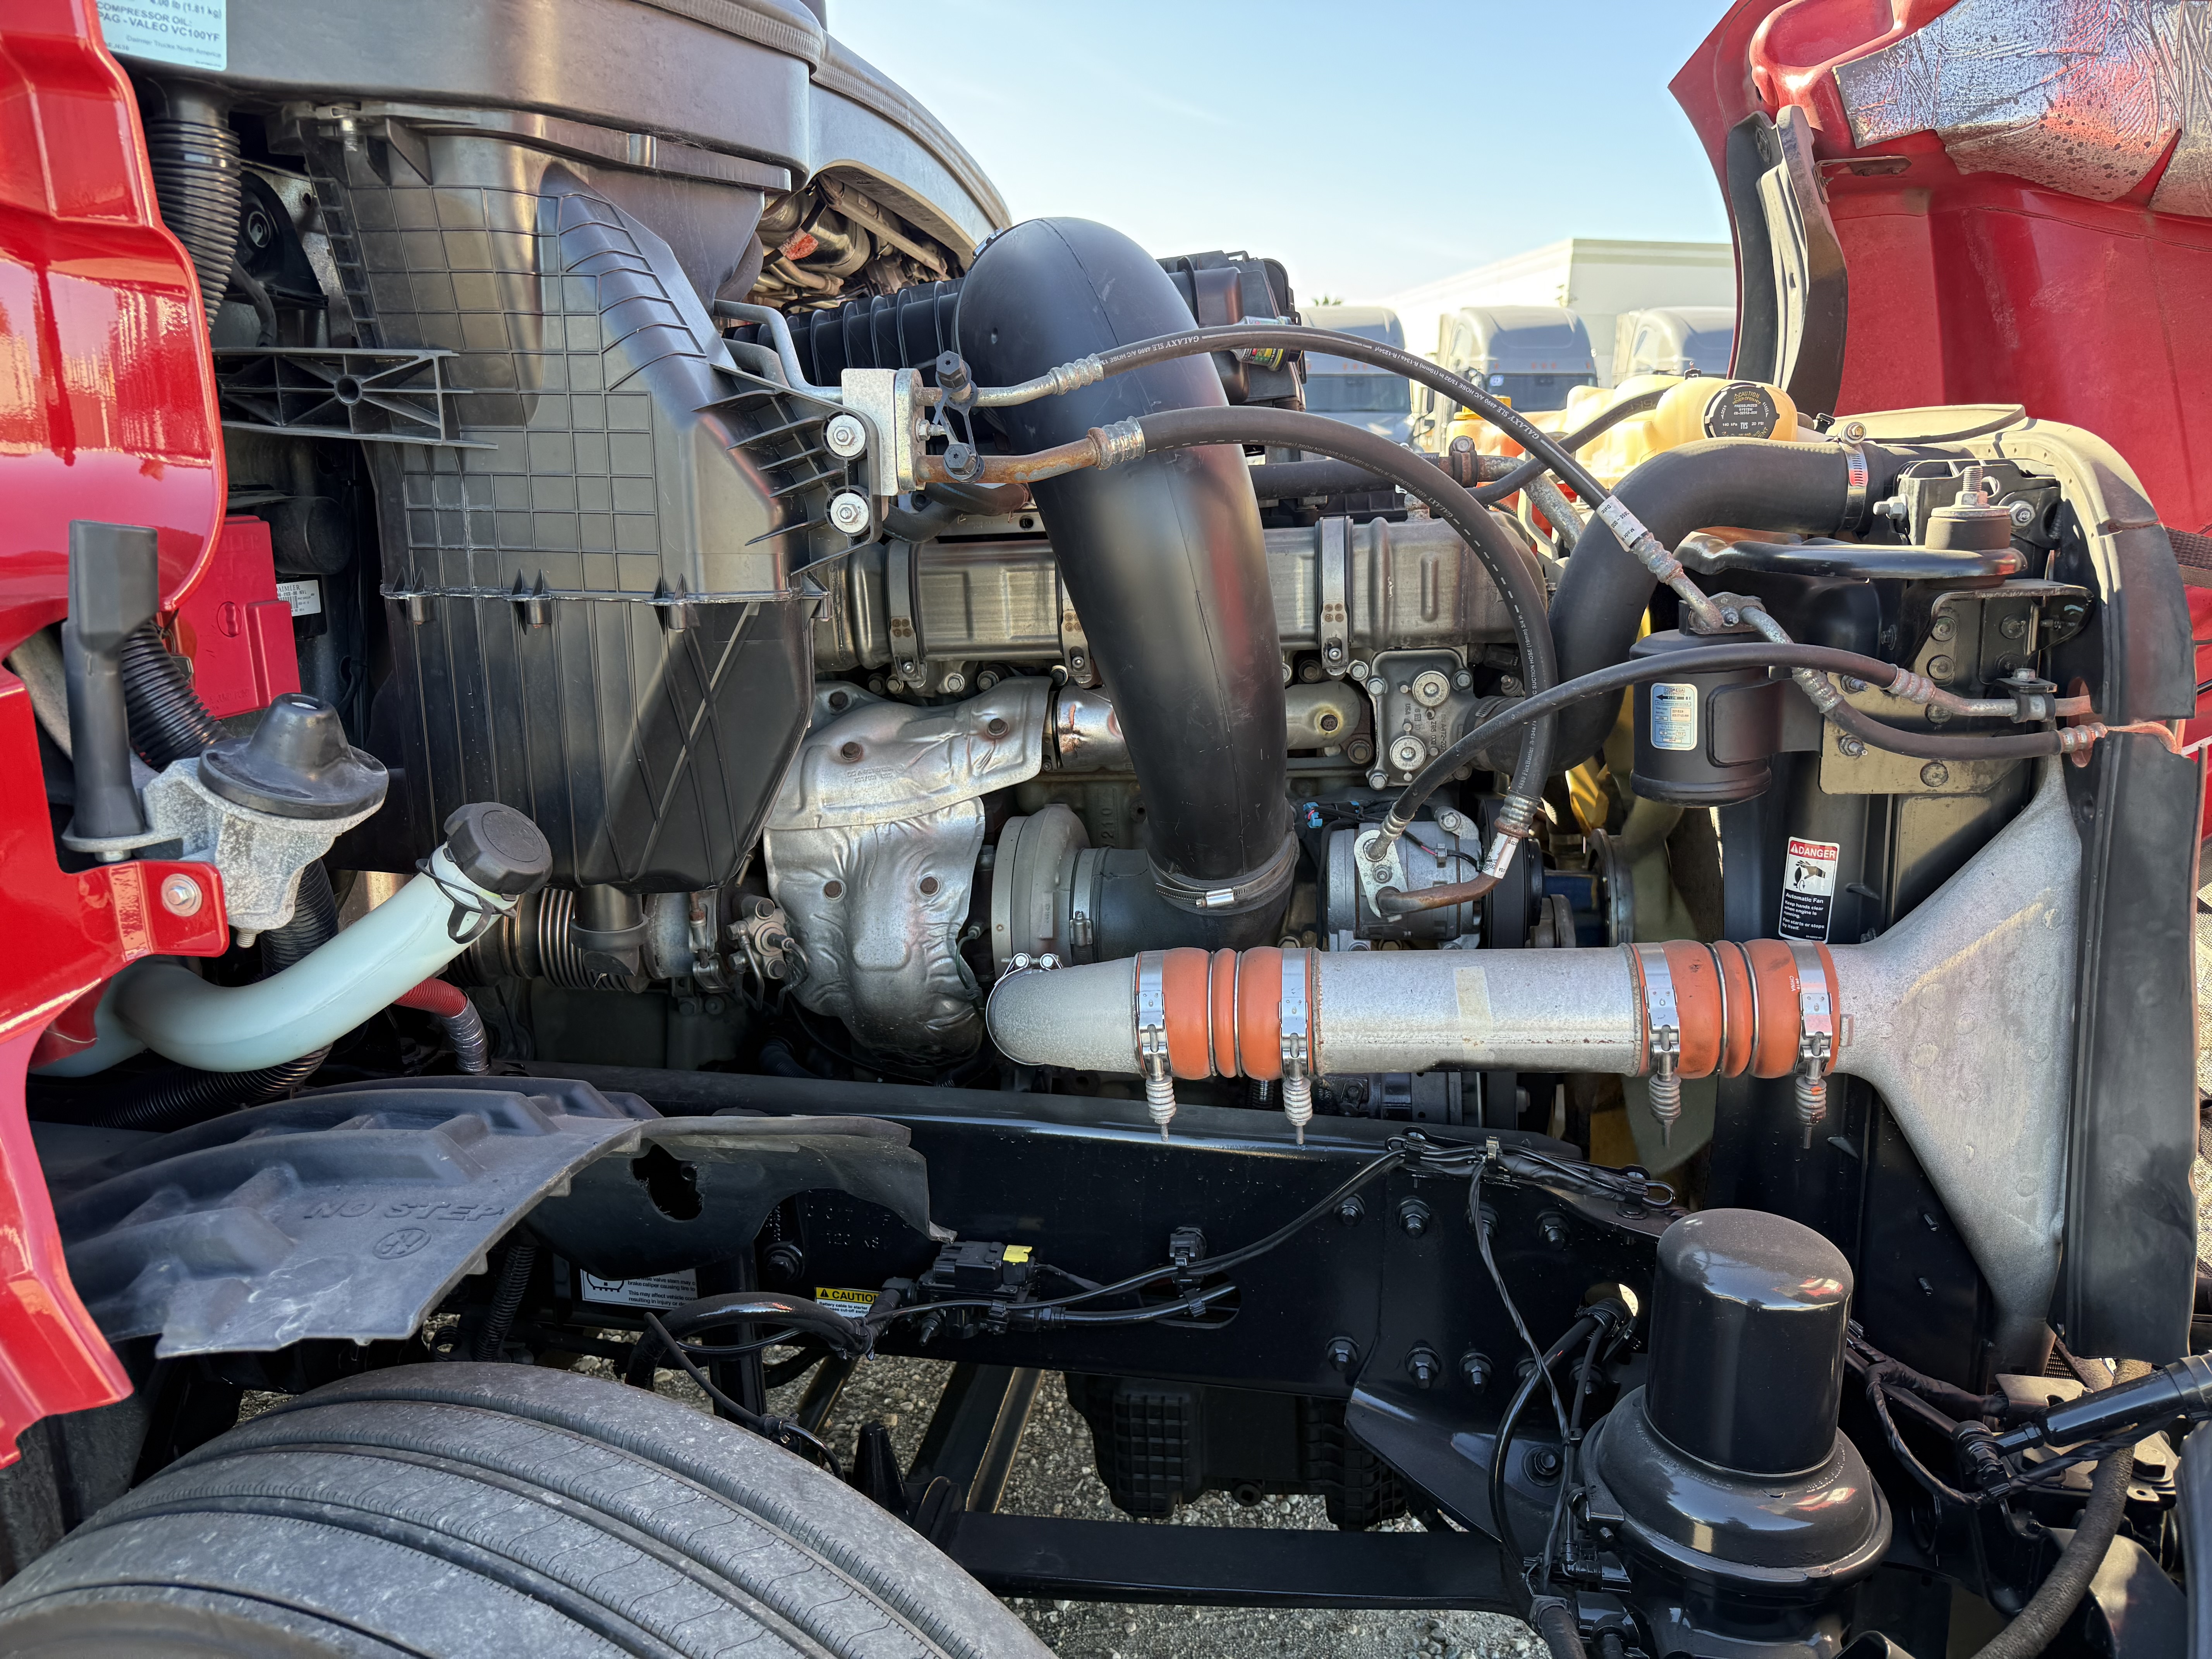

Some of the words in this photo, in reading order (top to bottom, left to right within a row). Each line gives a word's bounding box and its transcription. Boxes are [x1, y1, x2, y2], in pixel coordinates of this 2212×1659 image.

[96, 2, 169, 22] COMPRESSOR
[172, 15, 192, 27] OIL:
[129, 17, 168, 32] VALEO
[171, 27, 220, 42] VC100YF
[1152, 343, 1164, 351] SLE
[1166, 335, 1199, 348] GALAXY
[1109, 354, 1126, 362] HOSE
[1420, 363, 1439, 375] (10mm)
[1444, 375, 1458, 386] 13/32
[1458, 383, 1474, 395] HOSE
[1474, 392, 1485, 401] A/C
[1497, 407, 1509, 417] SLE
[1508, 415, 1540, 440] GALAXY
[1314, 447, 1338, 456] SUCTION
[1390, 474, 1416, 491] FlexBarrier
[1425, 497, 1453, 518] GALAXY
[1623, 527, 1635, 538] Made
[1522, 629, 1532, 647] (19mm)
[1522, 747, 1534, 776] FlexBarrier
[1518, 776, 1526, 790] 4880
[1799, 846, 1835, 859] DANGER
[1786, 893, 1811, 902] Automatic
[303, 1200, 376, 1218] NO
[384, 1201, 505, 1221] STEP
